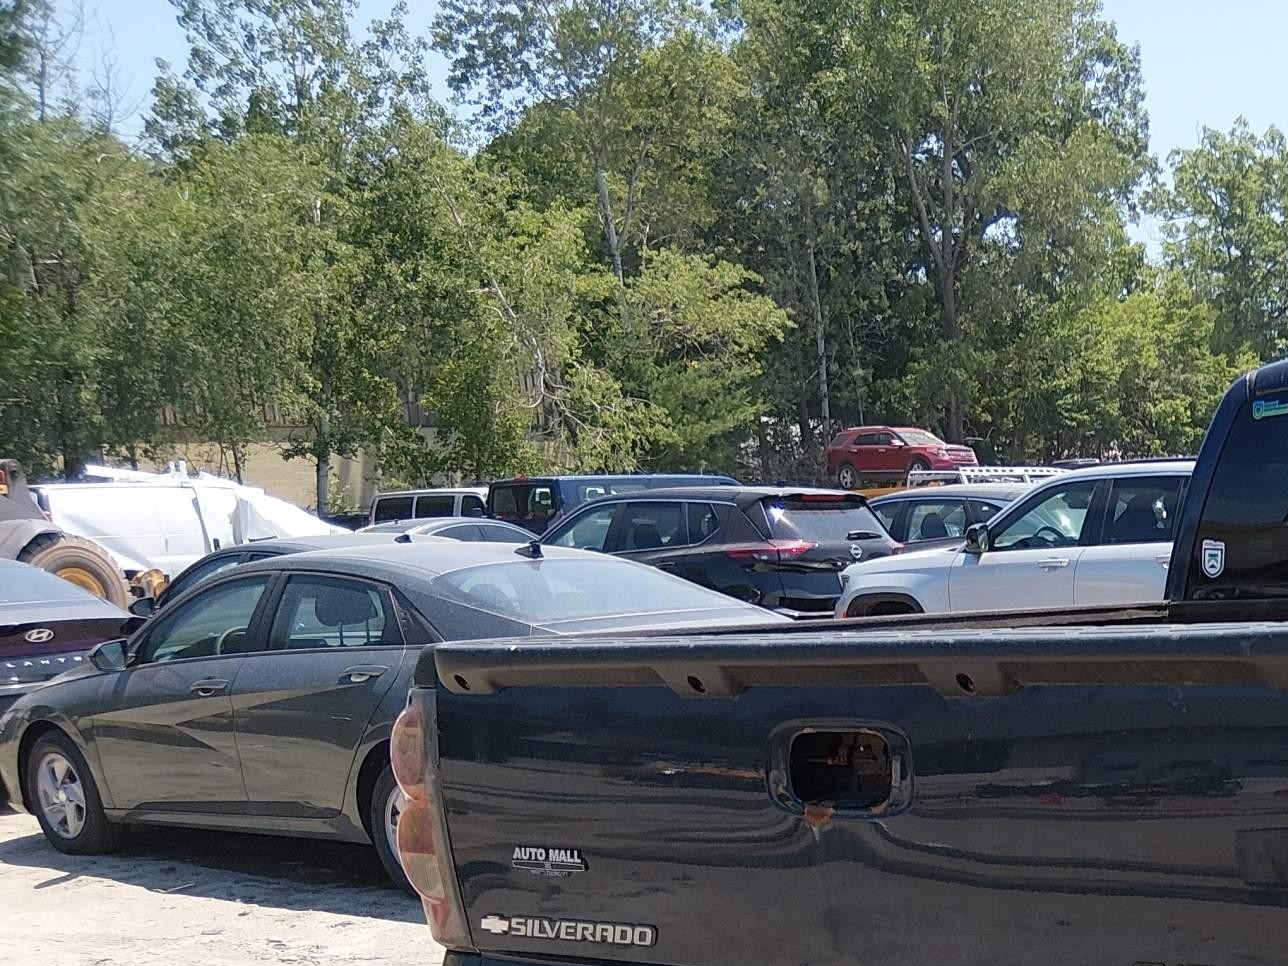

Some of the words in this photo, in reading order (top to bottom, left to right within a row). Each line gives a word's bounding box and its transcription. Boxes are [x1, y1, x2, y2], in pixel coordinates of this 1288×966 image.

[513, 846, 546, 861] AUTO
[549, 848, 582, 863] MALL
[511, 917, 653, 946] SILVERADO
